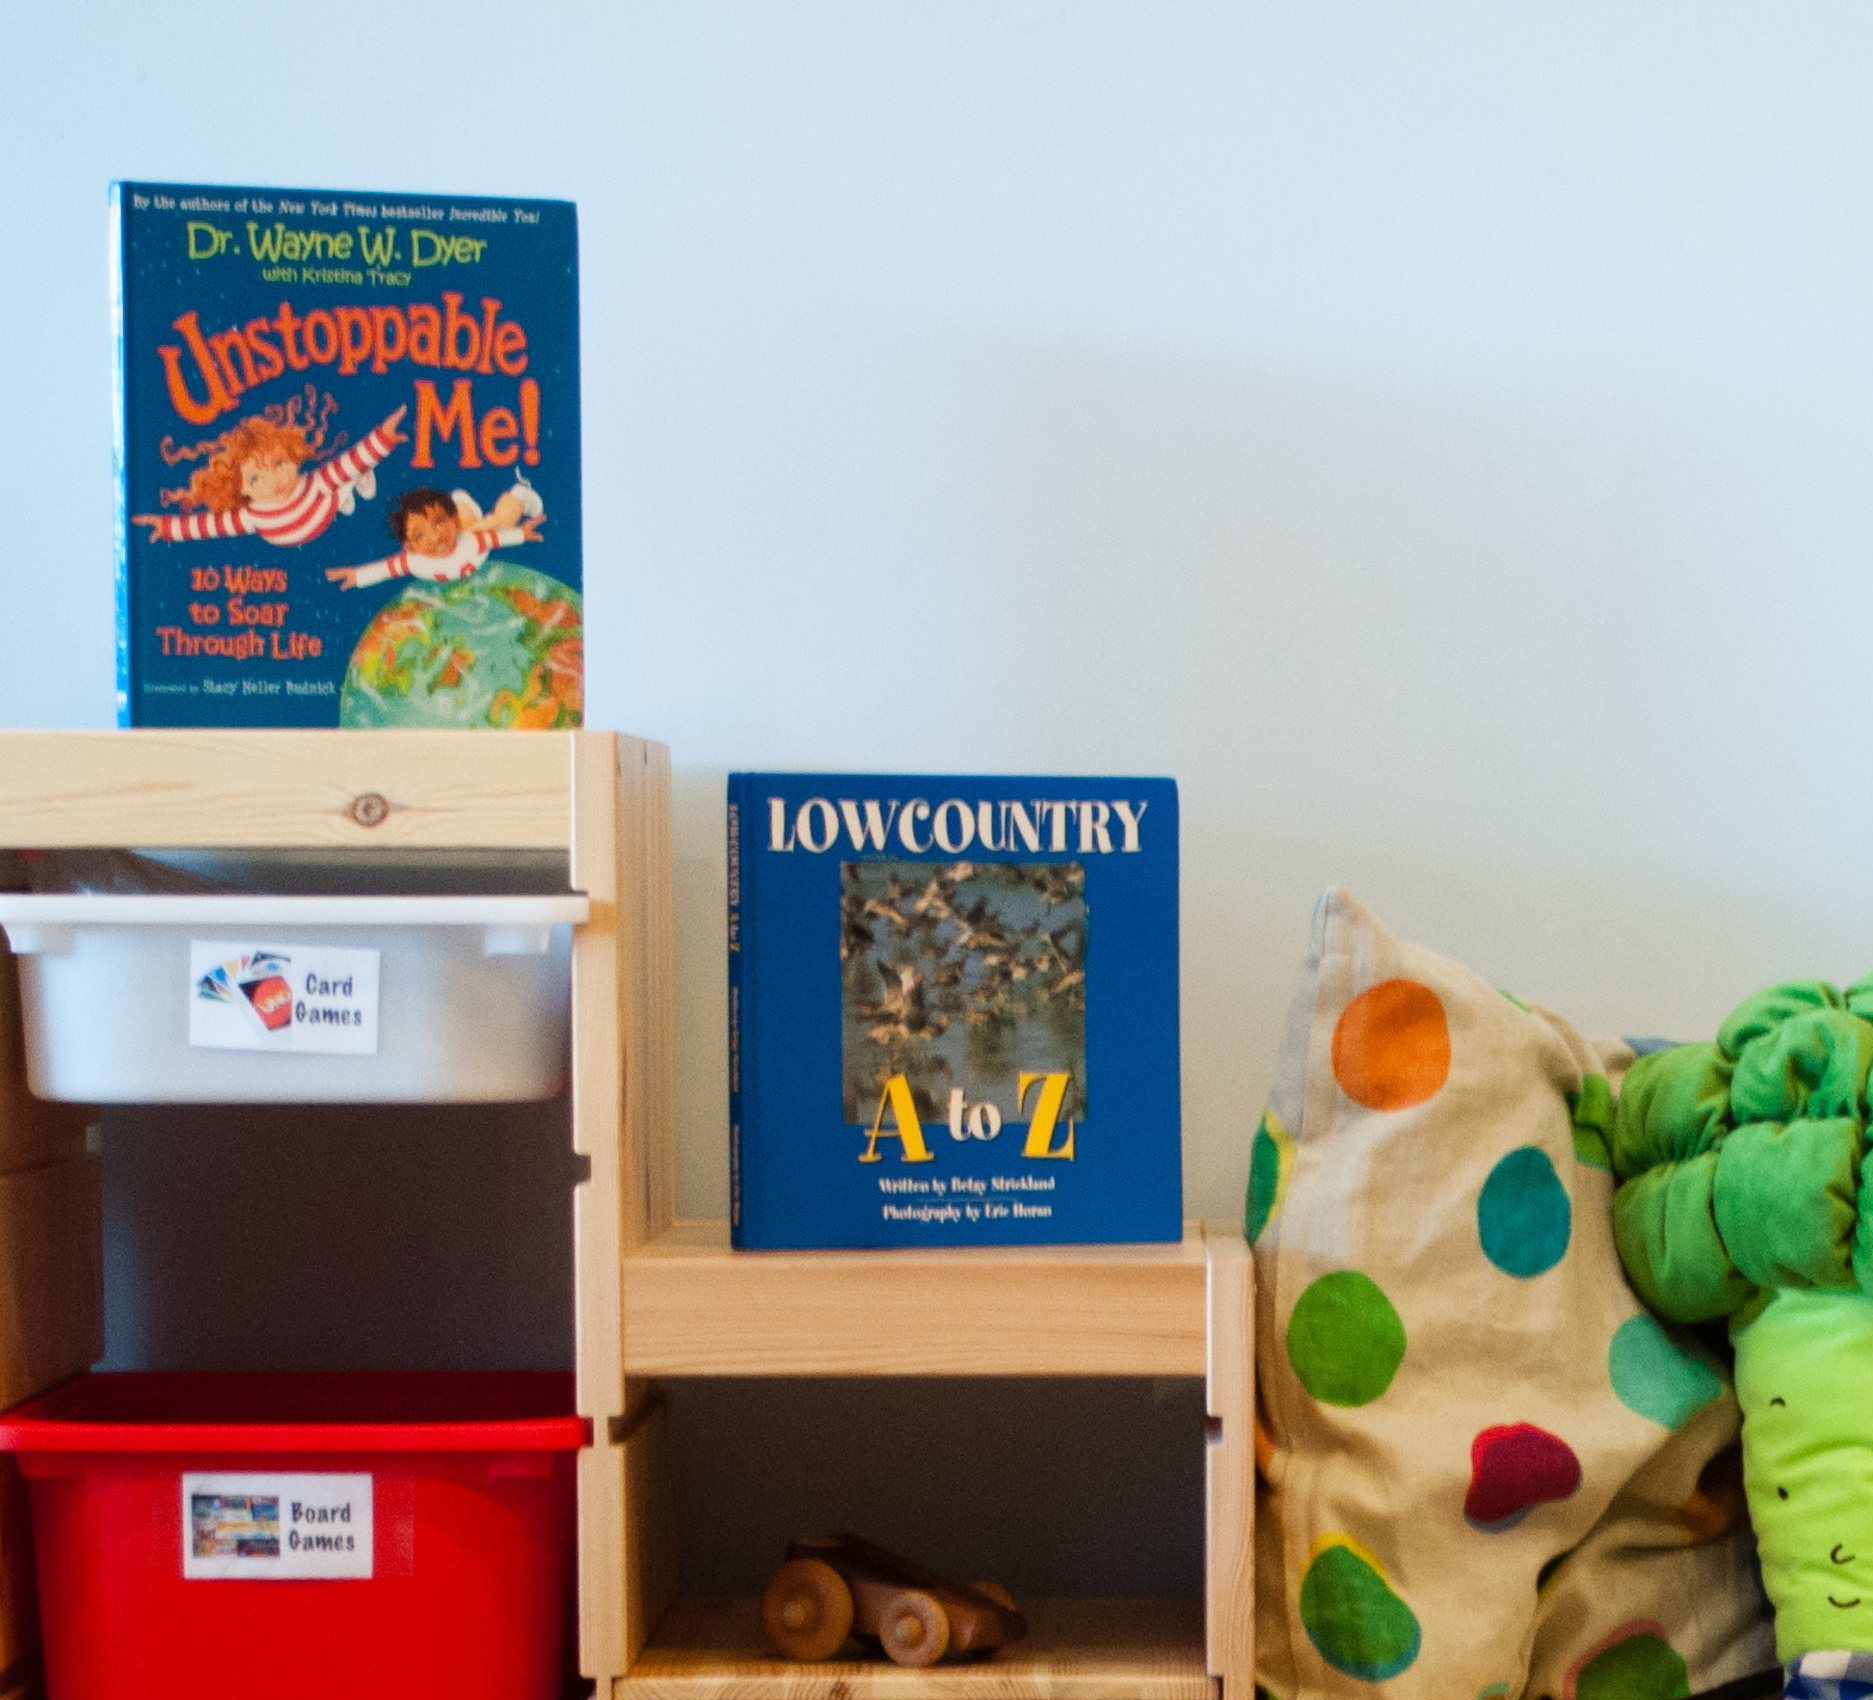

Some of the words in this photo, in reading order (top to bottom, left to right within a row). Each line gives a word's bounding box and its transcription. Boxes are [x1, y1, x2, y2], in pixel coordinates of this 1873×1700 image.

[154, 194, 175, 209] the
[180, 196, 230, 212] authors
[235, 197, 248, 213] of
[252, 198, 273, 214] the
[279, 199, 305, 215] New
[187, 221, 240, 259] Dr.
[246, 221, 353, 263] Wayne
[358, 225, 402, 267] W.
[411, 228, 488, 268] Dyer
[262, 266, 298, 284] with
[302, 268, 363, 285] Kristina
[367, 268, 411, 287] Tracy
[159, 292, 528, 425] Unstoppable
[410, 378, 541, 468] Me!
[191, 566, 220, 592] 10
[223, 564, 288, 594] Ways
[188, 601, 221, 625] to
[227, 596, 289, 626] Soar
[156, 626, 265, 660] Through
[270, 630, 322, 660] Life
[767, 797, 1148, 853] LOWCOUNTRY
[306, 973, 353, 997] Card
[295, 1001, 362, 1026] Games
[859, 1073, 934, 1163] A
[948, 1087, 1001, 1141] to
[1018, 1071, 1075, 1162] Z
[878, 1177, 929, 1194] Written
[932, 1177, 946, 1196] by
[991, 1175, 1055, 1191] Strickland
[882, 1204, 961, 1223] Photography
[965, 1204, 980, 1222] by
[291, 1502, 352, 1524] Board
[289, 1528, 356, 1551] Games
